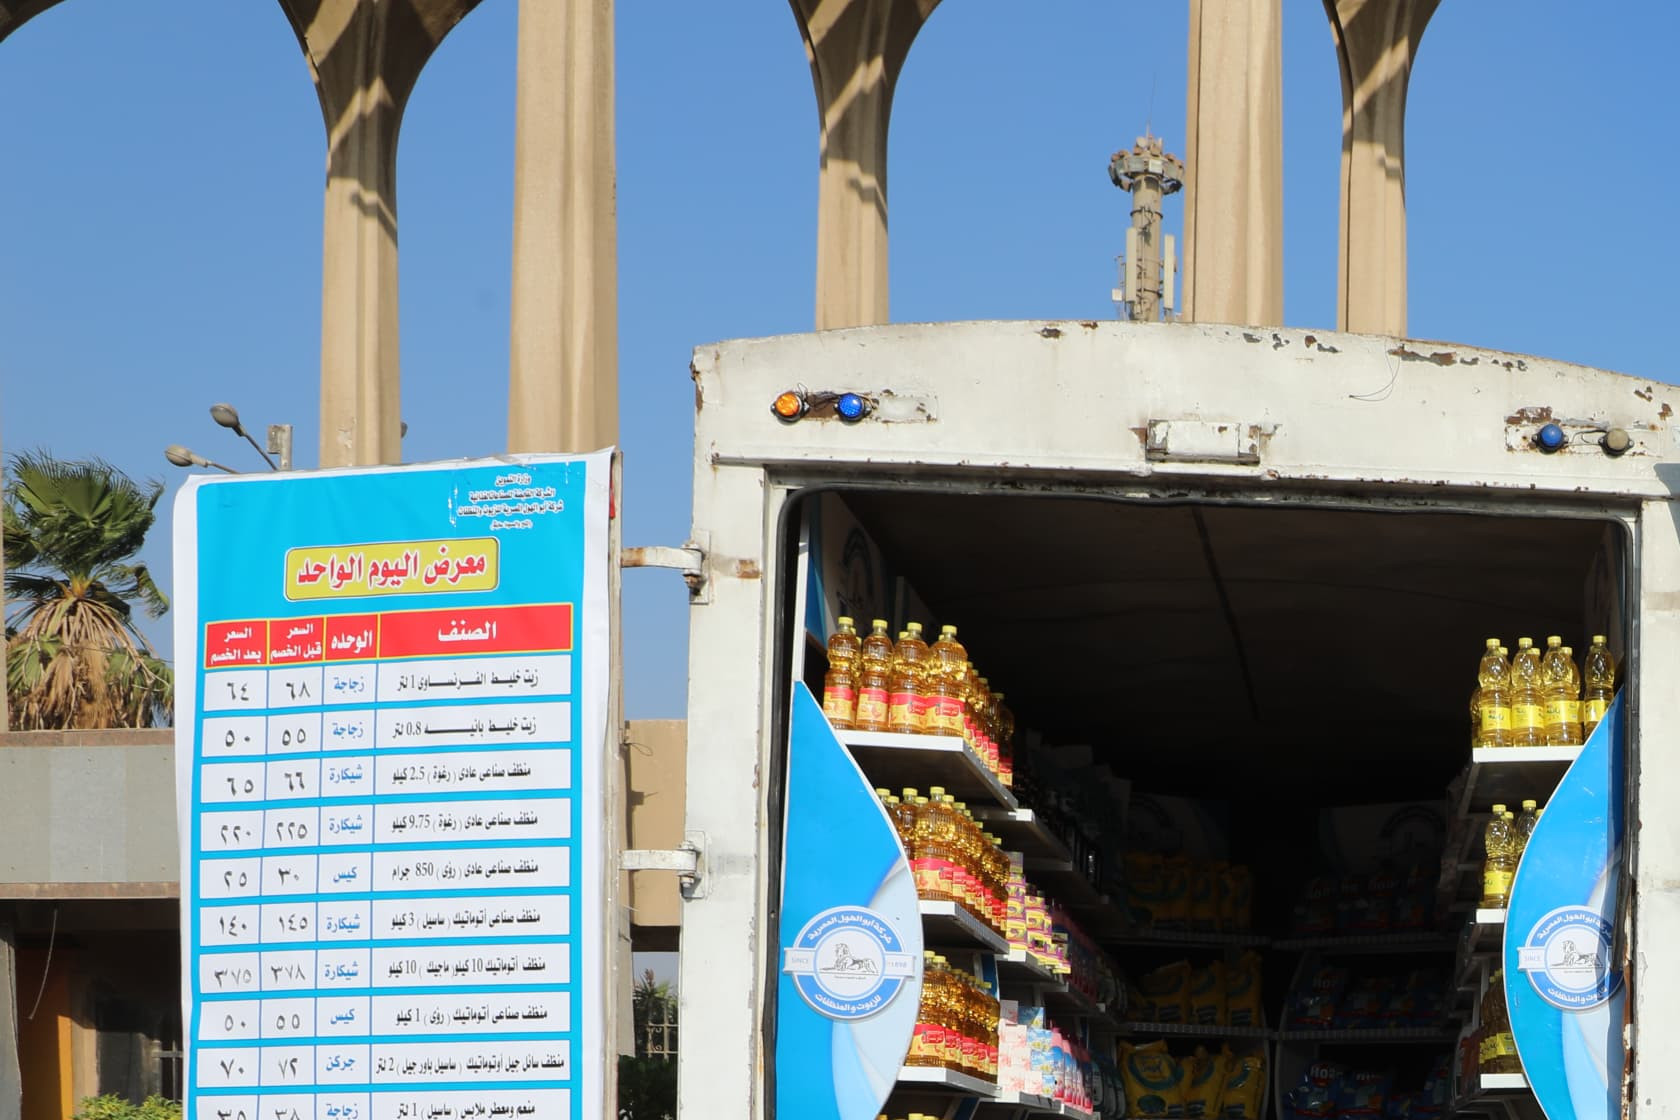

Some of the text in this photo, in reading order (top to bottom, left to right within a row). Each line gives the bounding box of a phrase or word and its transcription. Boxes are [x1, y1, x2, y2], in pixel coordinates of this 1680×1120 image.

[298, 545, 486, 589] معرض اليوم الواحد
[224, 627, 252, 641] السعر
[287, 624, 313, 639] السعر
[437, 619, 497, 641] الصنف
[210, 647, 261, 664] بعد الخصم
[270, 642, 322, 659] قبل الخصم
[334, 677, 364, 693] زجاجة
[398, 670, 538, 691] زيت لتر
[227, 683, 249, 701] ٦٤
[286, 682, 310, 700] ٦٨
[226, 730, 250, 747] ٥٠
[282, 729, 306, 746] ٥٥
[333, 722, 363, 739] زجاجة
[330, 764, 362, 783] شيكارة
[392, 768, 407, 784] كيلو
[410, 766, 424, 780] 2.5
[508, 763, 531, 776] منظف
[227, 778, 254, 796] ٦٥
[285, 772, 304, 791] ٦٦
[330, 815, 362, 833] شيكارة
[334, 867, 357, 883] كيس
[416, 862, 433, 876] 850
[514, 860, 538, 873] منظف
[279, 914, 307, 931] ١٤٥
[327, 914, 360, 933] شيكارة
[392, 914, 406, 930] كيلو
[408, 912, 414, 926] 3
[517, 909, 540, 923] منظف
[220, 916, 246, 936] ١٤٠
[325, 962, 358, 980] شيكارة
[225, 1015, 246, 1031] ٥٠
[276, 1014, 300, 1030] ٥٥
[331, 1009, 354, 1024] كيس
[220, 1059, 244, 1078] ٧٠
[326, 1056, 355, 1071] جركن
[326, 1104, 358, 1120] زجاجة
[397, 1103, 408, 1119] لتر
